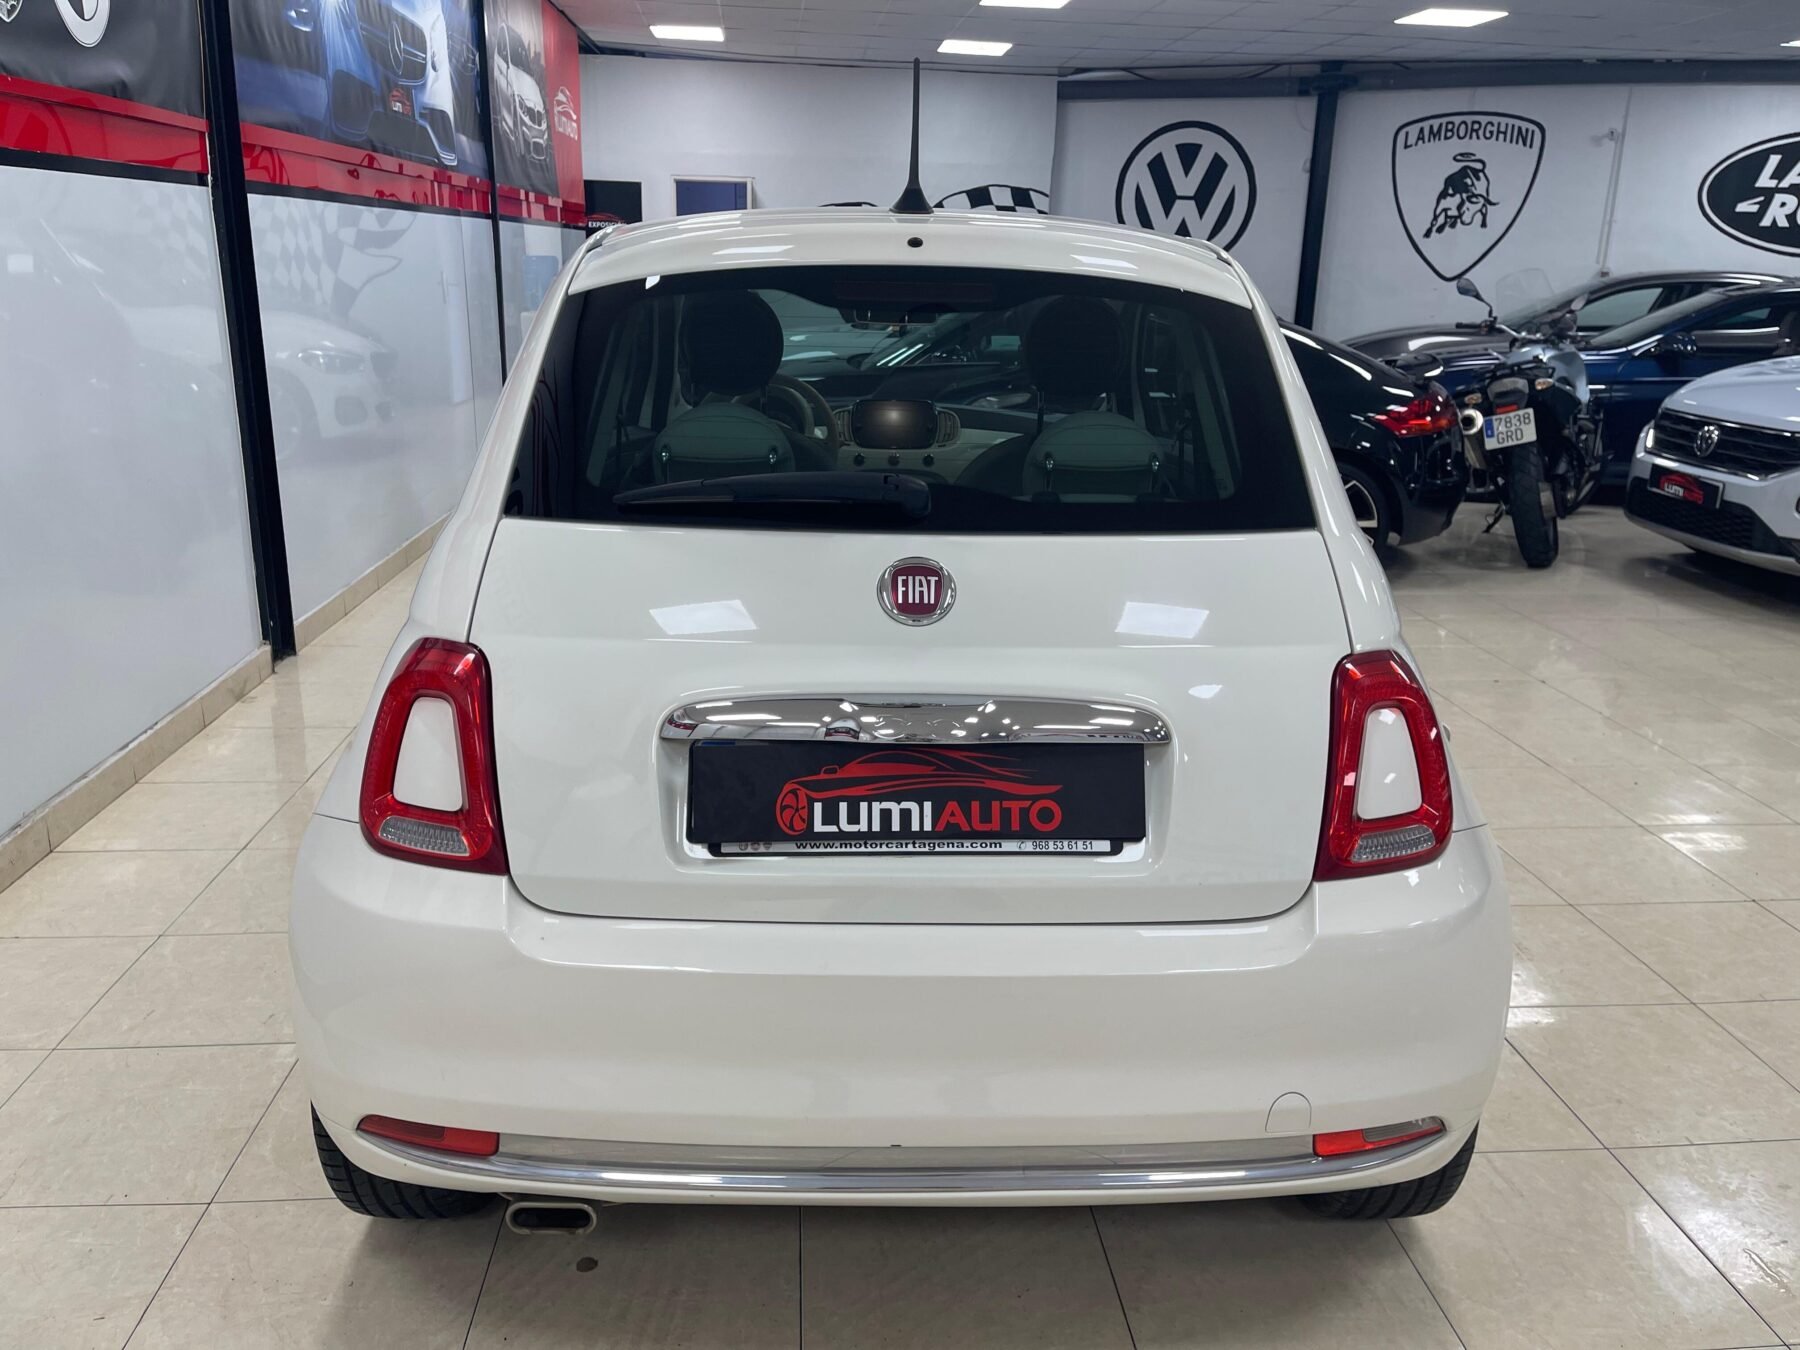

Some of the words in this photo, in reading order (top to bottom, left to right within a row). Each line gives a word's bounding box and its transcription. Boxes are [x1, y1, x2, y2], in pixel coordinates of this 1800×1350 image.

[1403, 120, 1535, 150] LAMBORGHINI
[1758, 192, 1800, 228] R
[1495, 412, 1531, 431] 7838
[1496, 428, 1524, 445] GRD
[897, 575, 939, 604] FIAT
[812, 799, 1062, 833] LUMIAUTO
[795, 840, 1003, 851] www.motorcartagena.com
[1031, 840, 1050, 851] 968
[1053, 840, 1065, 851] 53
[1067, 840, 1079, 851] 61
[1082, 840, 1093, 851] 51
